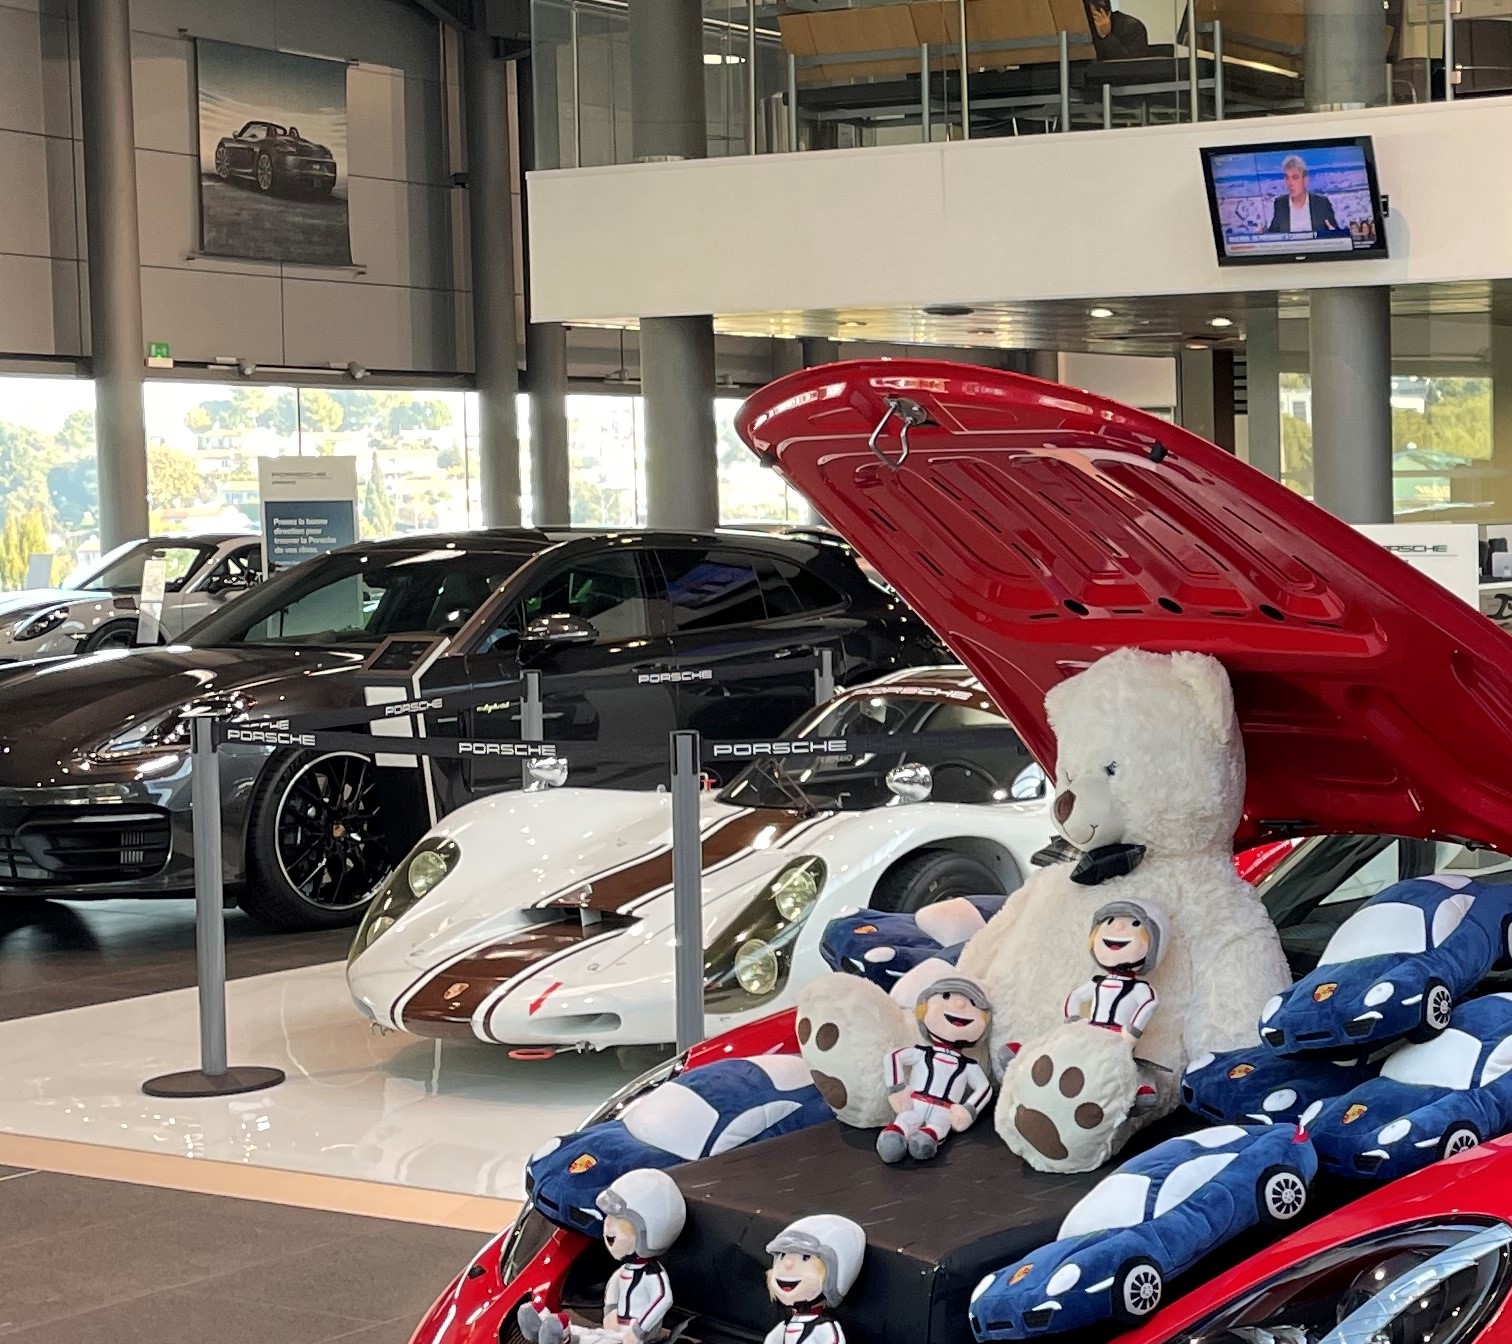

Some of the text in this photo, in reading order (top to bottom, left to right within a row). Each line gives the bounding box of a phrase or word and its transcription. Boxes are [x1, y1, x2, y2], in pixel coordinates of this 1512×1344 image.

[638, 670, 712, 684] PORSCHE
[852, 686, 973, 701] PORSCHE
[385, 698, 442, 716] PORSCHE
[227, 729, 315, 746] PORSCHE
[458, 742, 556, 756] PORSCHE
[714, 740, 847, 756] PORSCHE
